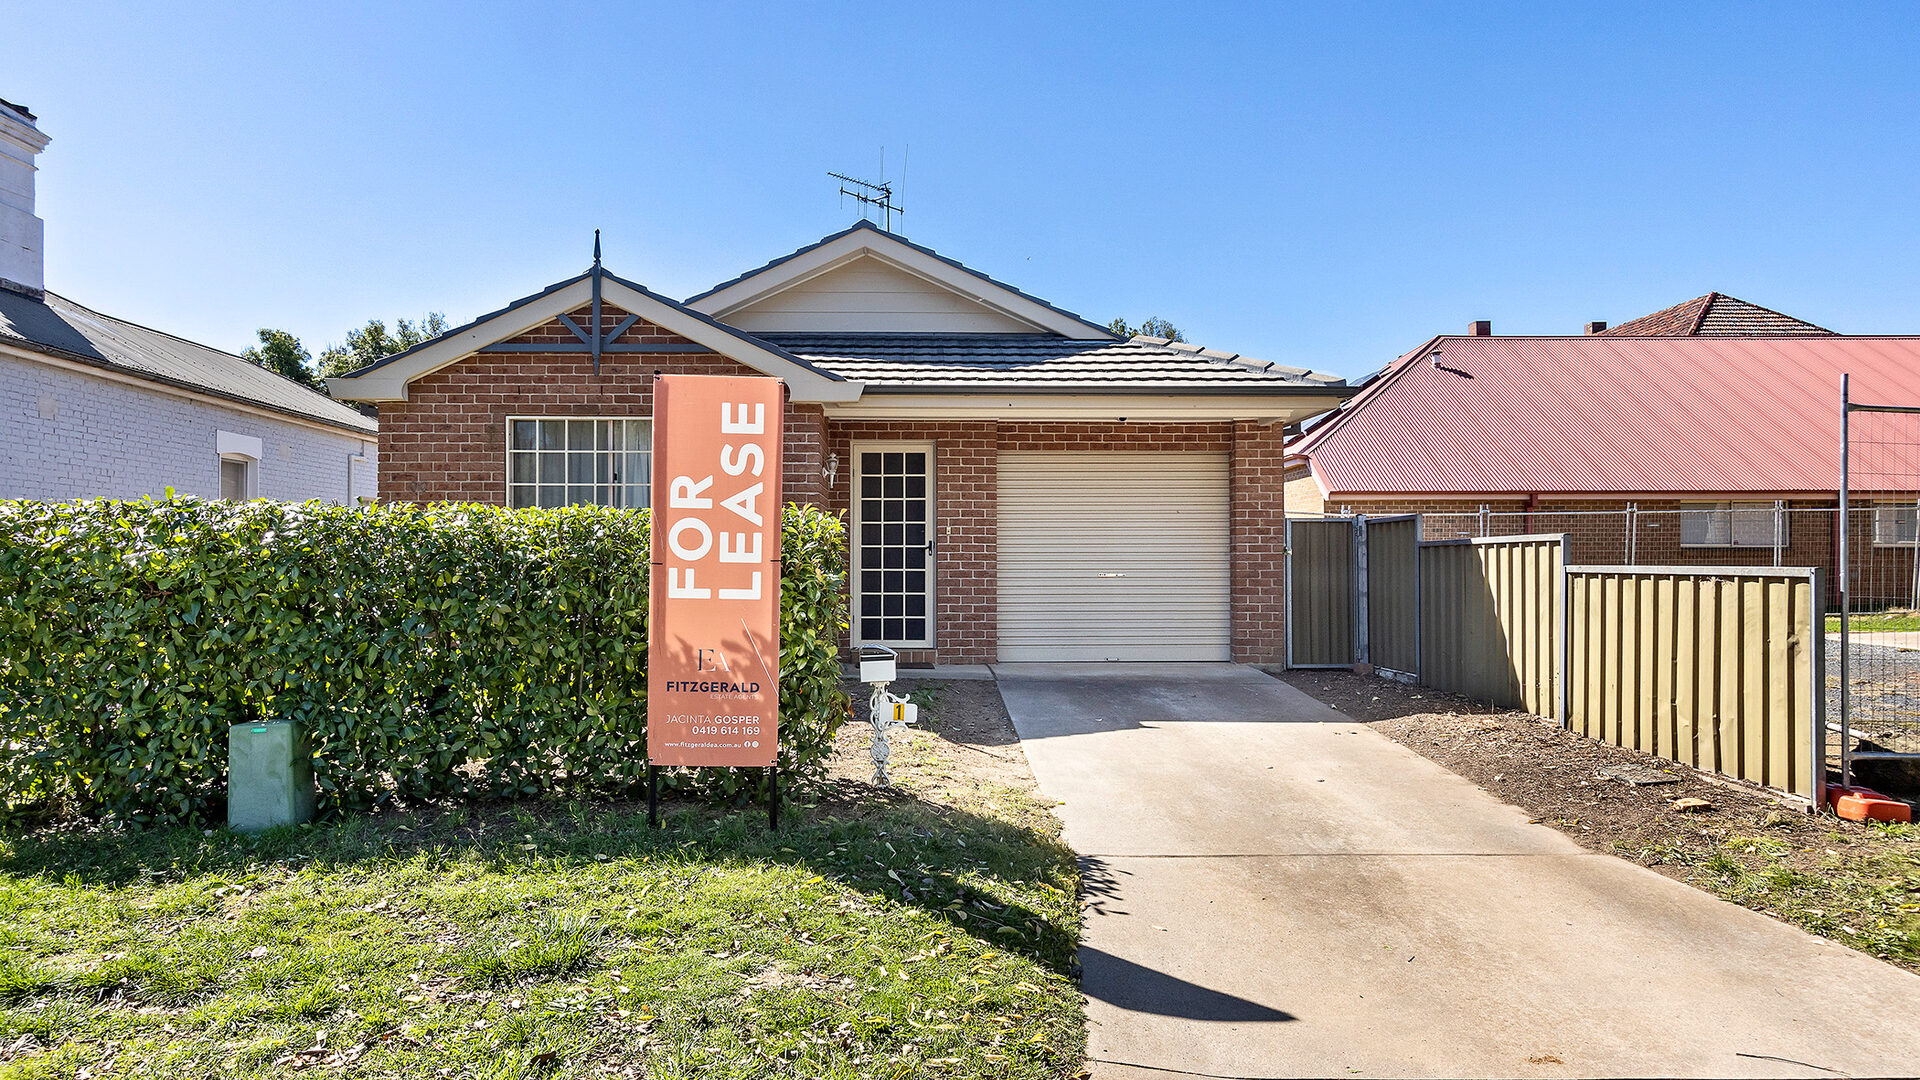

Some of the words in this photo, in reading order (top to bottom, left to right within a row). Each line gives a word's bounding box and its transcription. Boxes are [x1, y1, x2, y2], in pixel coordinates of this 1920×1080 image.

[718, 402, 765, 600] LEASE
[668, 475, 713, 599] FOR
[666, 681, 760, 693] FITZGERALD
[895, 704, 902, 720] 1
[666, 714, 712, 724] JACINTA
[714, 715, 760, 725] GOSPER
[692, 726, 718, 735] 0419
[720, 726, 739, 735] 614
[742, 726, 760, 735] 169
[664, 741, 742, 749] www.fitzgeraldea.com.au
